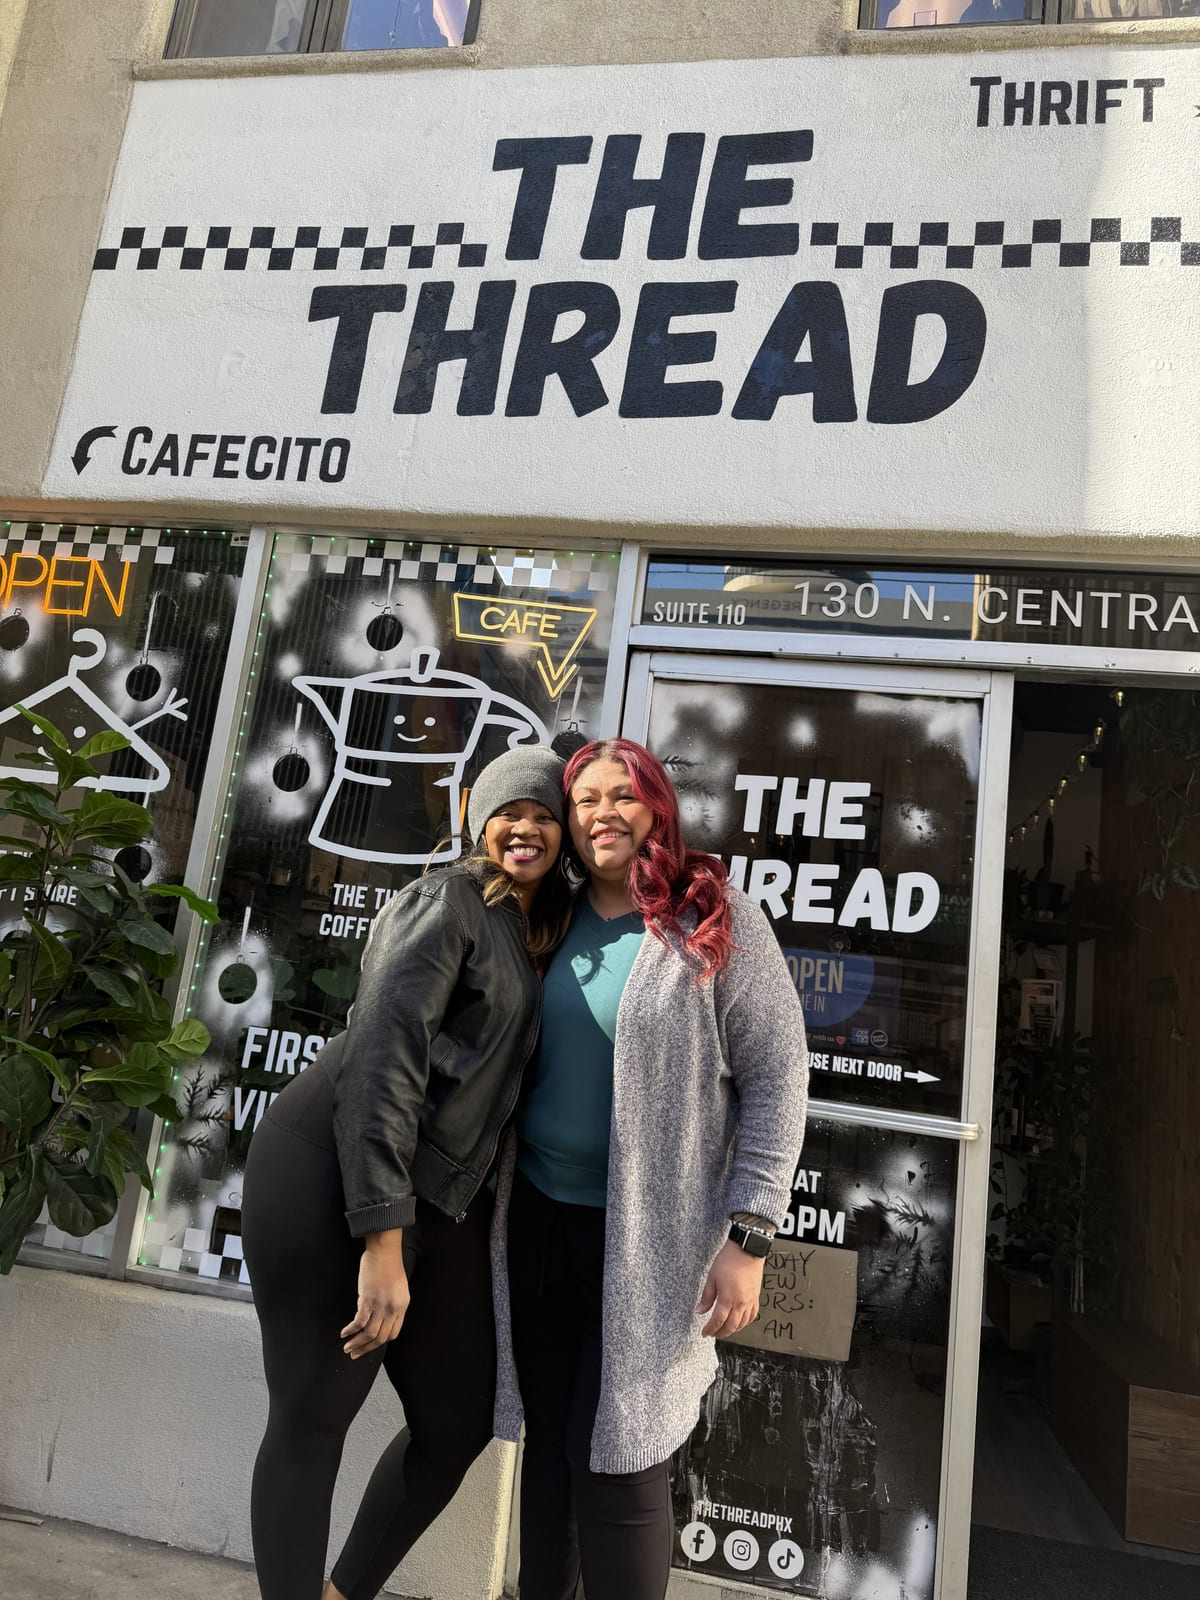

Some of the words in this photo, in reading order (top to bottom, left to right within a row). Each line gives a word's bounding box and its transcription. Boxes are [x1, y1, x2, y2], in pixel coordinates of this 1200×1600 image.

[970, 76, 1165, 127] THRIFT
[492, 129, 814, 261] THE
[307, 279, 988, 425] THREAD
[121, 426, 351, 483] CAFECITO
[0, 552, 130, 617] PEN
[480, 607, 562, 638] CAFE
[652, 601, 709, 624] SUITE
[716, 603, 746, 626] 110
[794, 580, 879, 619] 130
[902, 584, 950, 621] N.
[977, 586, 1199, 633] CENTRA
[734, 774, 871, 840] THE
[333, 883, 368, 908] THE
[708, 853, 940, 933] READ
[319, 913, 376, 940] COFF
[785, 955, 844, 994] OPEN
[813, 995, 825, 1013] IN
[241, 1026, 334, 1075] FIRS
[832, 1055, 864, 1076] NEXT
[867, 1061, 902, 1082] DOOR
[234, 1086, 280, 1133] VI
[793, 1169, 822, 1194] AT
[764, 1249, 816, 1276] RDAY
[763, 1272, 796, 1290] EW
[760, 1292, 813, 1314] URS:
[763, 1319, 793, 1340] AM
